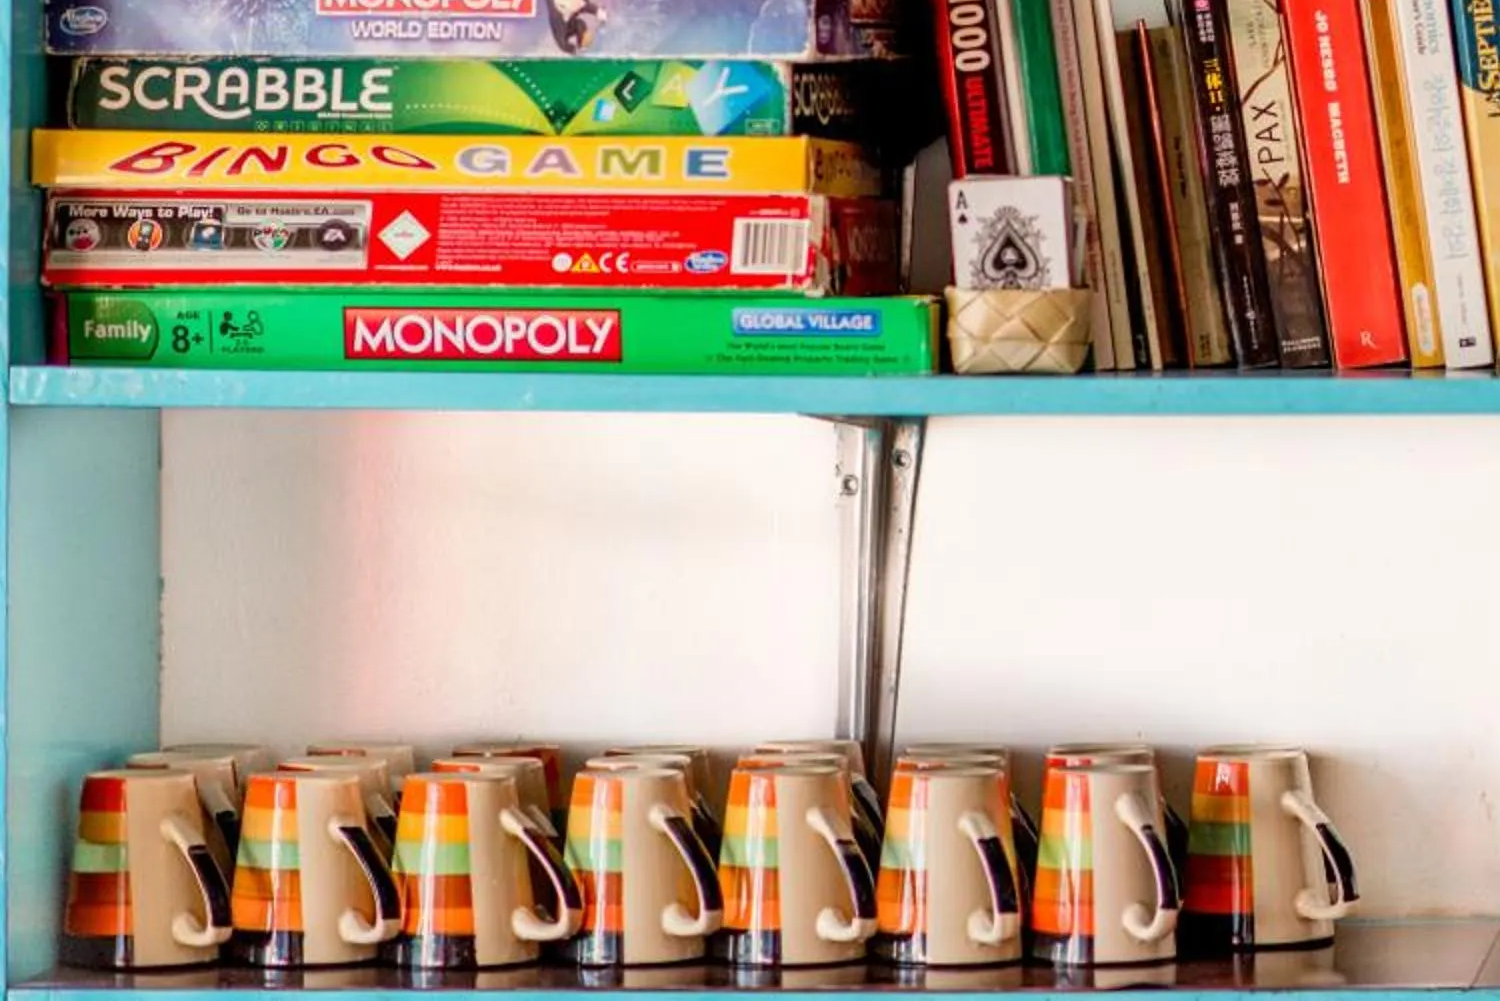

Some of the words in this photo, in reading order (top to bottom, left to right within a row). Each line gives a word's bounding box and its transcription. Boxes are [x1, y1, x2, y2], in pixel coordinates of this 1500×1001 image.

[351, 20, 421, 39] WORLD
[428, 20, 501, 40] EDITION
[99, 65, 394, 120] SCRABBLE
[1315, 9, 1330, 30] JO
[1329, 102, 1352, 184] MACBETH
[964, 76, 995, 169] ULTIMATE
[1250, 100, 1282, 165] PAX
[109, 141, 437, 179] BINGO
[459, 147, 731, 179] GAME
[68, 205, 108, 218] More
[112, 205, 154, 221] Ways
[156, 206, 175, 218] to
[177, 205, 216, 221] Play!
[956, 190, 970, 210] A
[84, 319, 152, 343] Family
[172, 324, 205, 354] 8+
[352, 313, 614, 356] MONOPOLY
[739, 314, 804, 331] GLOBAL
[806, 314, 873, 331] VILLAGE
